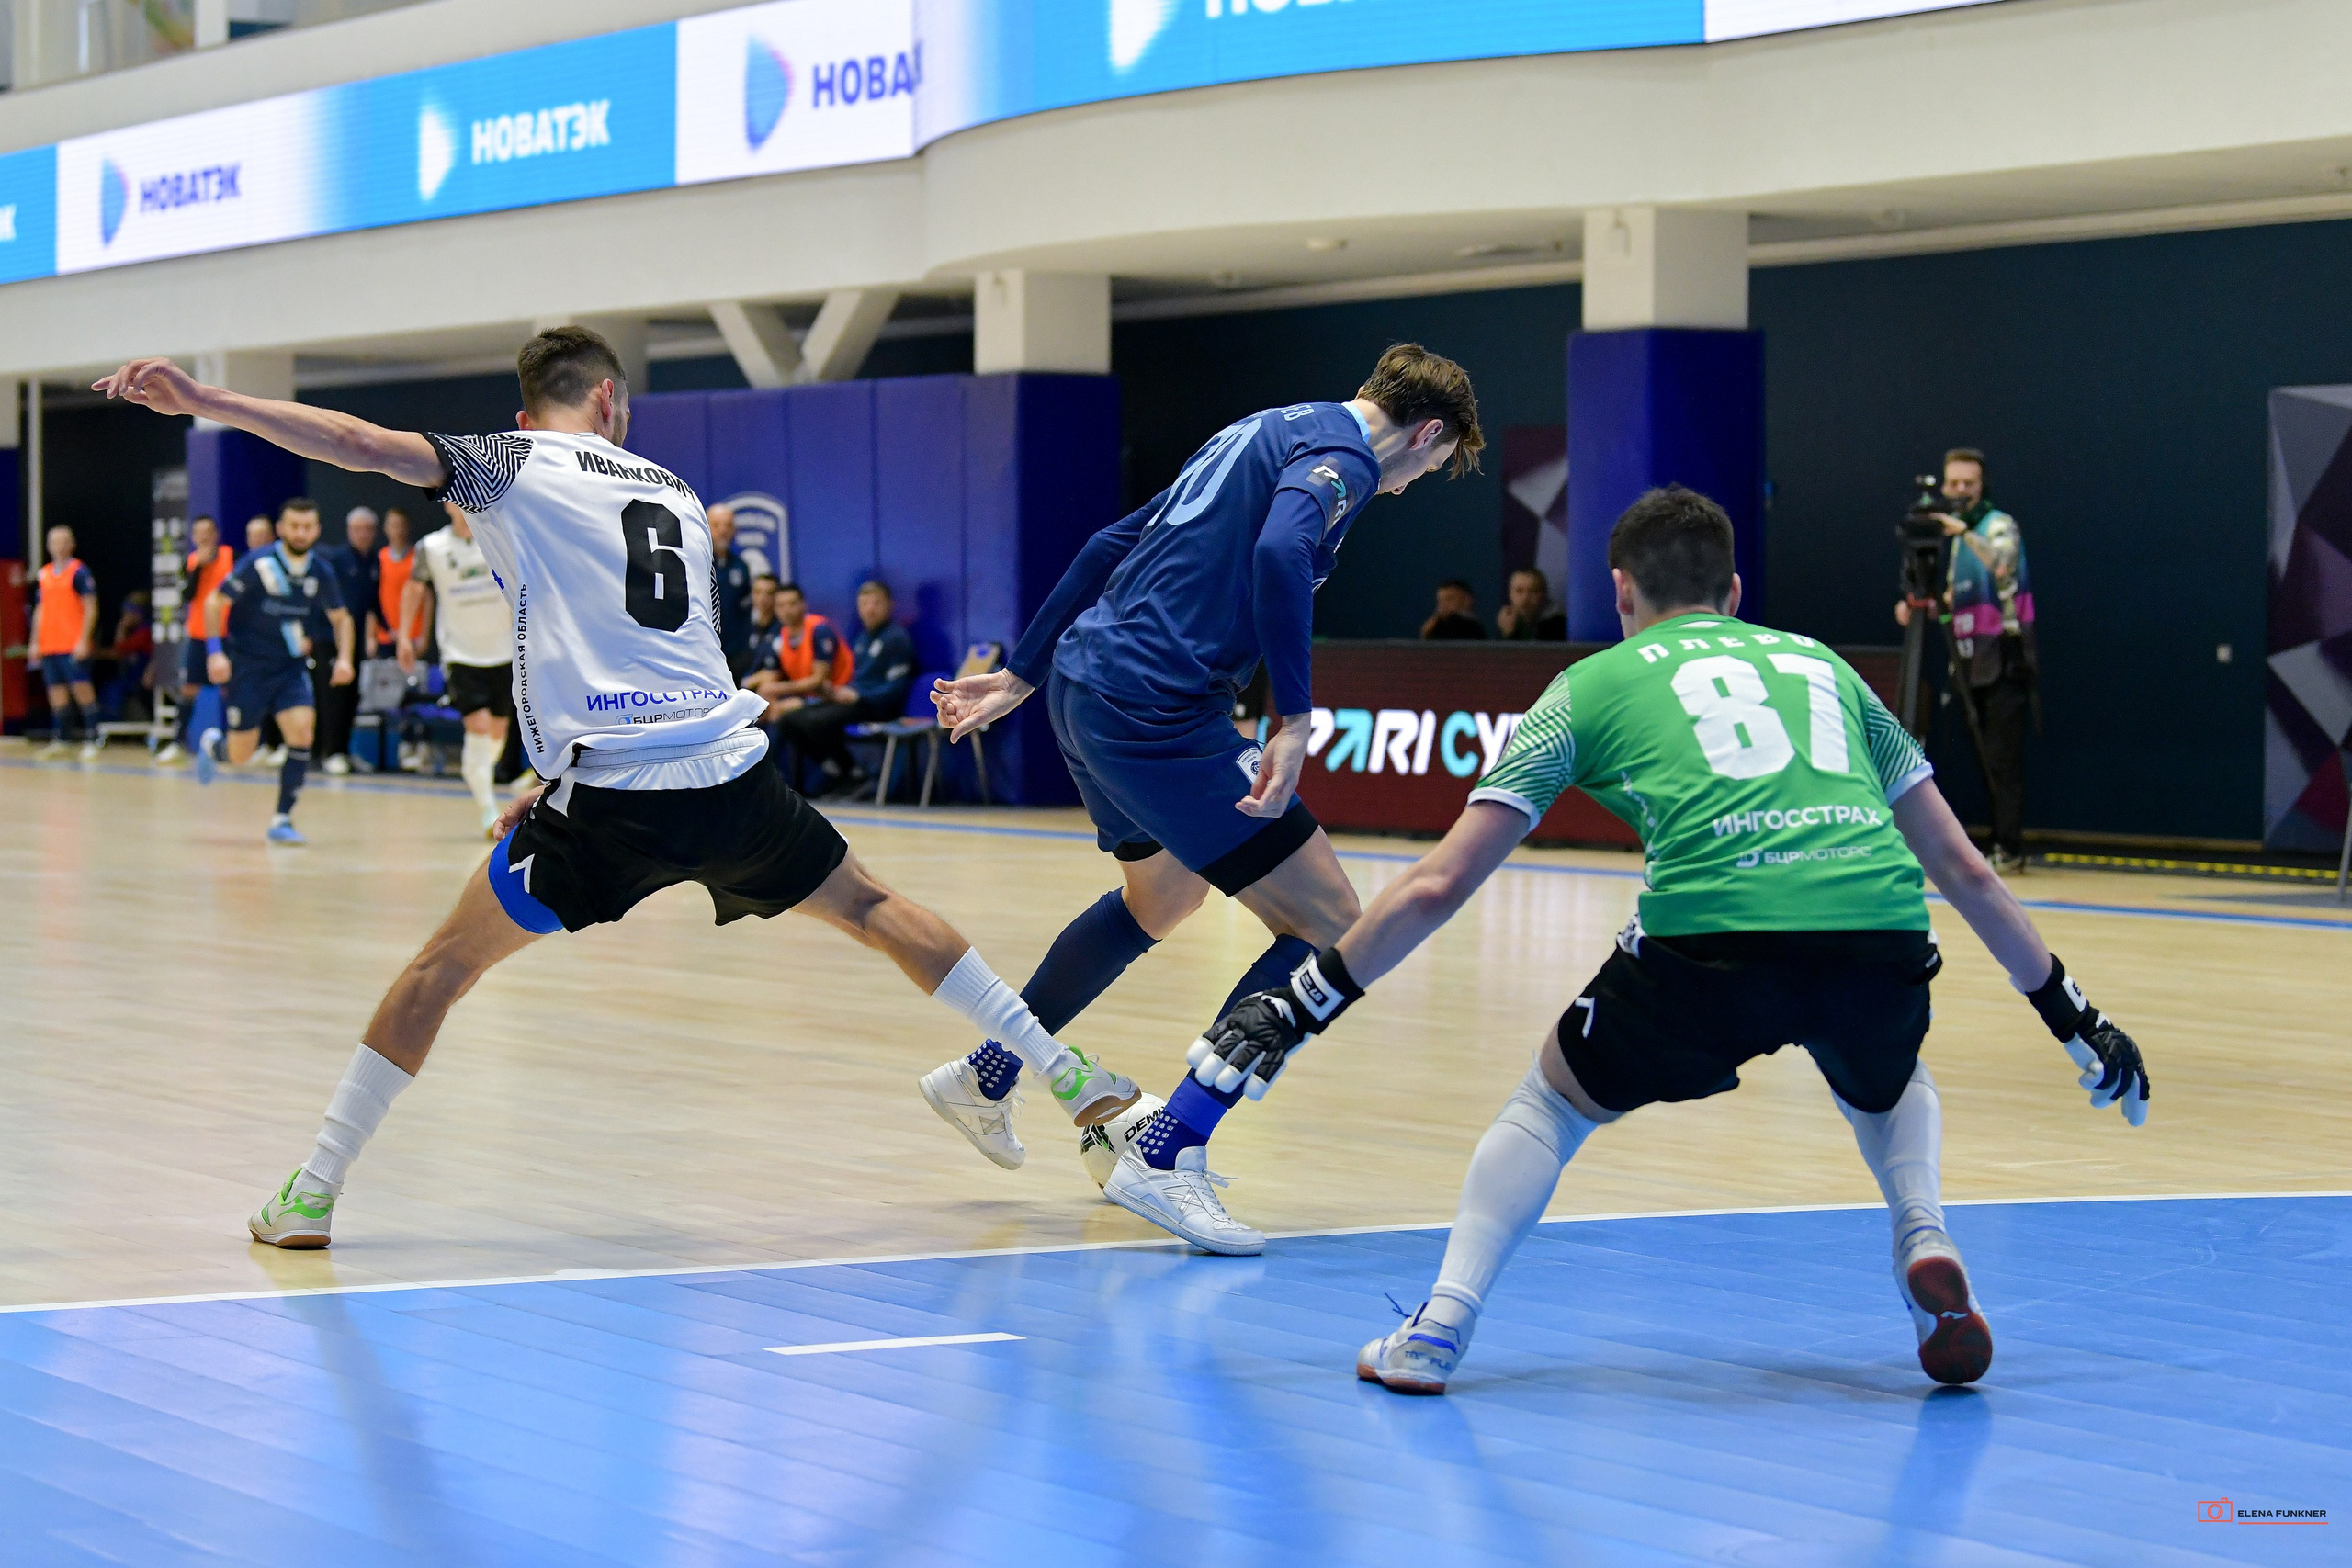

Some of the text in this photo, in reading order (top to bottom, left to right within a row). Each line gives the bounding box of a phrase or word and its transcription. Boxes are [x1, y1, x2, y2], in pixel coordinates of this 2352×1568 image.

[812, 39, 922, 108] НОВА
[471, 99, 611, 165] НОВАТЭК
[139, 163, 241, 213] НОВАТЭК
[574, 450, 698, 504] ИВАНКОВИЧ
[620, 498, 689, 633] 6
[516, 582, 545, 754] НИЖЕГОРОДСКАЯ ОБЛАСТЬ
[1306, 707, 1437, 775] PARI
[1670, 653, 1850, 781] 87
[1713, 805, 1883, 838] ИНГОССТРАХ
